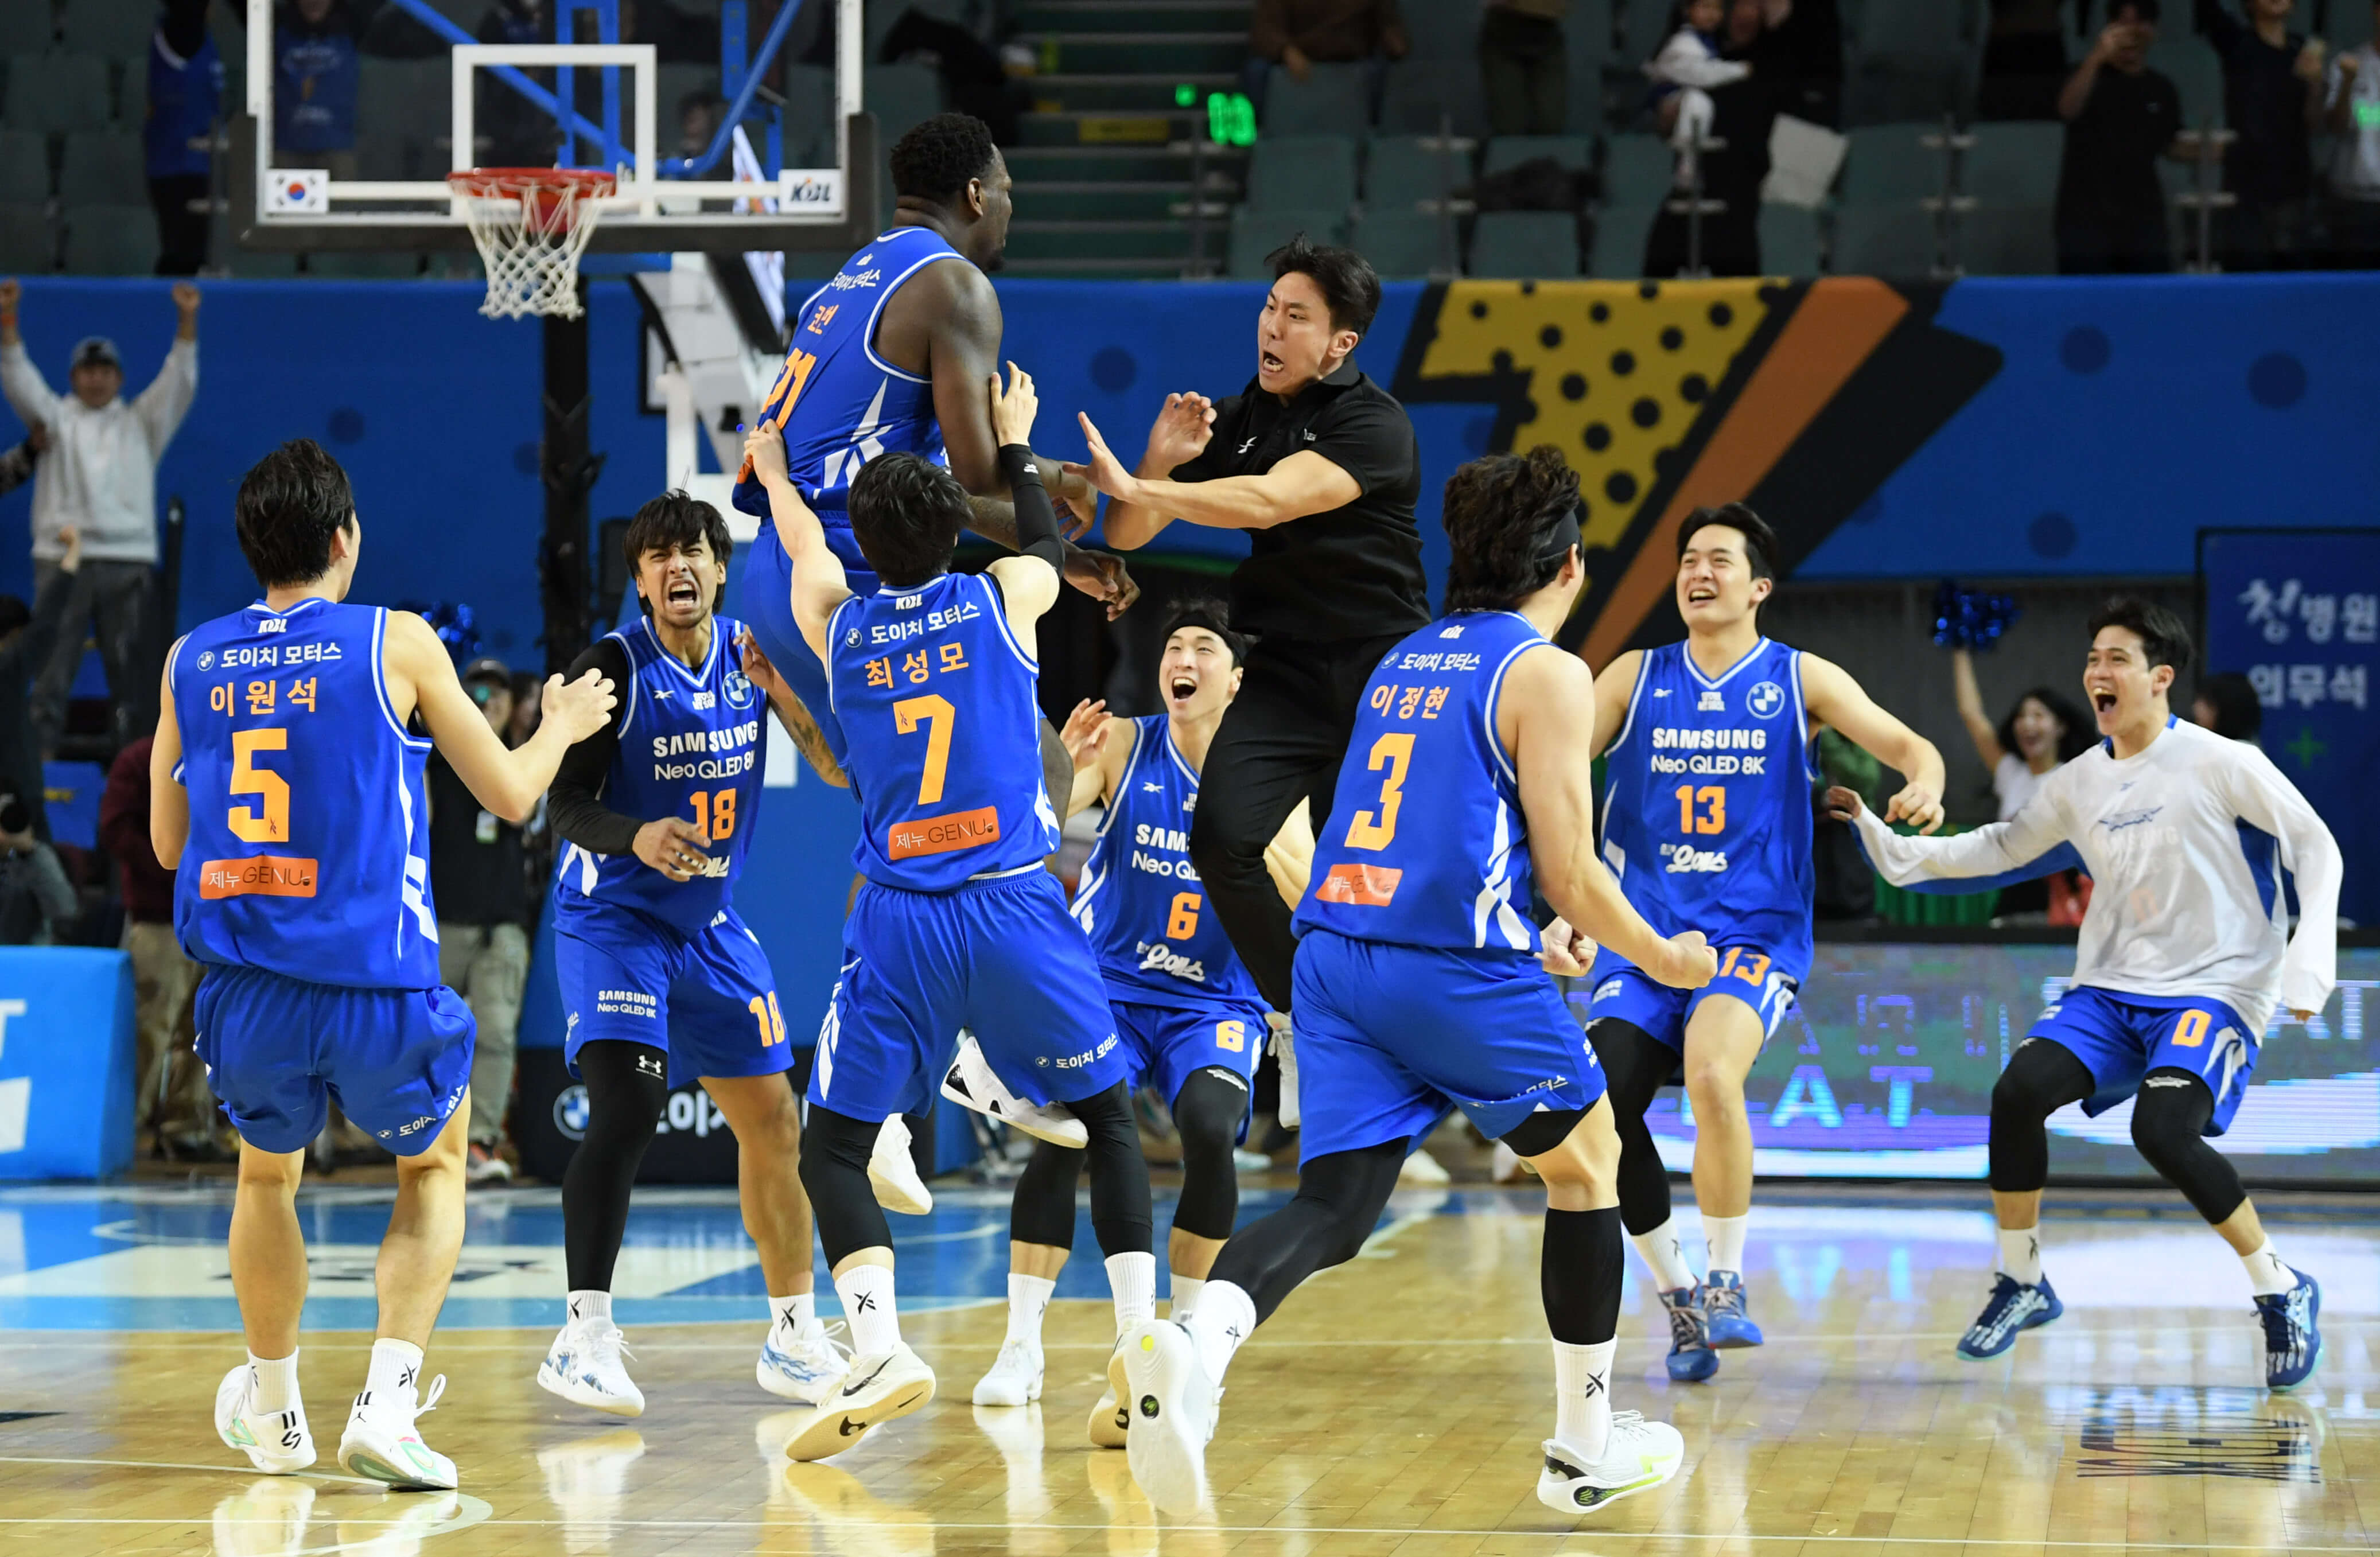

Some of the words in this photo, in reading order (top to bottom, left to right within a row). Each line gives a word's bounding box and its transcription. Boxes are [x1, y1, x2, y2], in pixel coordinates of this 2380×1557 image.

[895, 594, 923, 610] KBL
[259, 618, 287, 633] KBL
[870, 618, 923, 644] 도이치
[928, 601, 981, 631] 모터스
[220, 646, 277, 668] 도이치
[283, 642, 342, 664] 모터스
[864, 642, 969, 689] 최성모
[1397, 652, 1441, 672] 도이치
[1440, 652, 1481, 671] 모터스
[210, 677, 317, 717] 이원석
[1370, 684, 1450, 719] 이정현
[653, 721, 758, 758] SAMSUNG
[893, 694, 955, 805] 7
[1652, 727, 1767, 750] SAMSUNG
[654, 763, 696, 781] Neo
[698, 755, 742, 780] QLED
[1651, 754, 1687, 773] Neo
[1689, 755, 1740, 774] QLED
[1741, 756, 1767, 774] 8K
[228, 727, 290, 843] 5
[1344, 733, 1417, 851] 3
[690, 788, 737, 840] 18
[1675, 785, 1725, 835] 13
[896, 831, 926, 850] 제누
[928, 819, 986, 844] GENU
[1135, 823, 1190, 853] SAM
[208, 871, 240, 889] 제누
[242, 865, 304, 886] GENU
[1131, 850, 1173, 876] Neo
[1175, 861, 1203, 882] QL
[1166, 892, 1202, 941] 6
[1718, 947, 1772, 987] 13
[597, 1003, 619, 1013] Neo
[621, 1004, 645, 1015] QLED
[646, 1008, 656, 1019] 8K
[598, 990, 656, 1007] SAMSUNG
[748, 990, 785, 1048] 18
[1216, 1020, 1245, 1053] 6
[2171, 1009, 2212, 1048] 0
[1056, 1049, 1094, 1069] 도이치
[1096, 1032, 1118, 1060] 모터스
